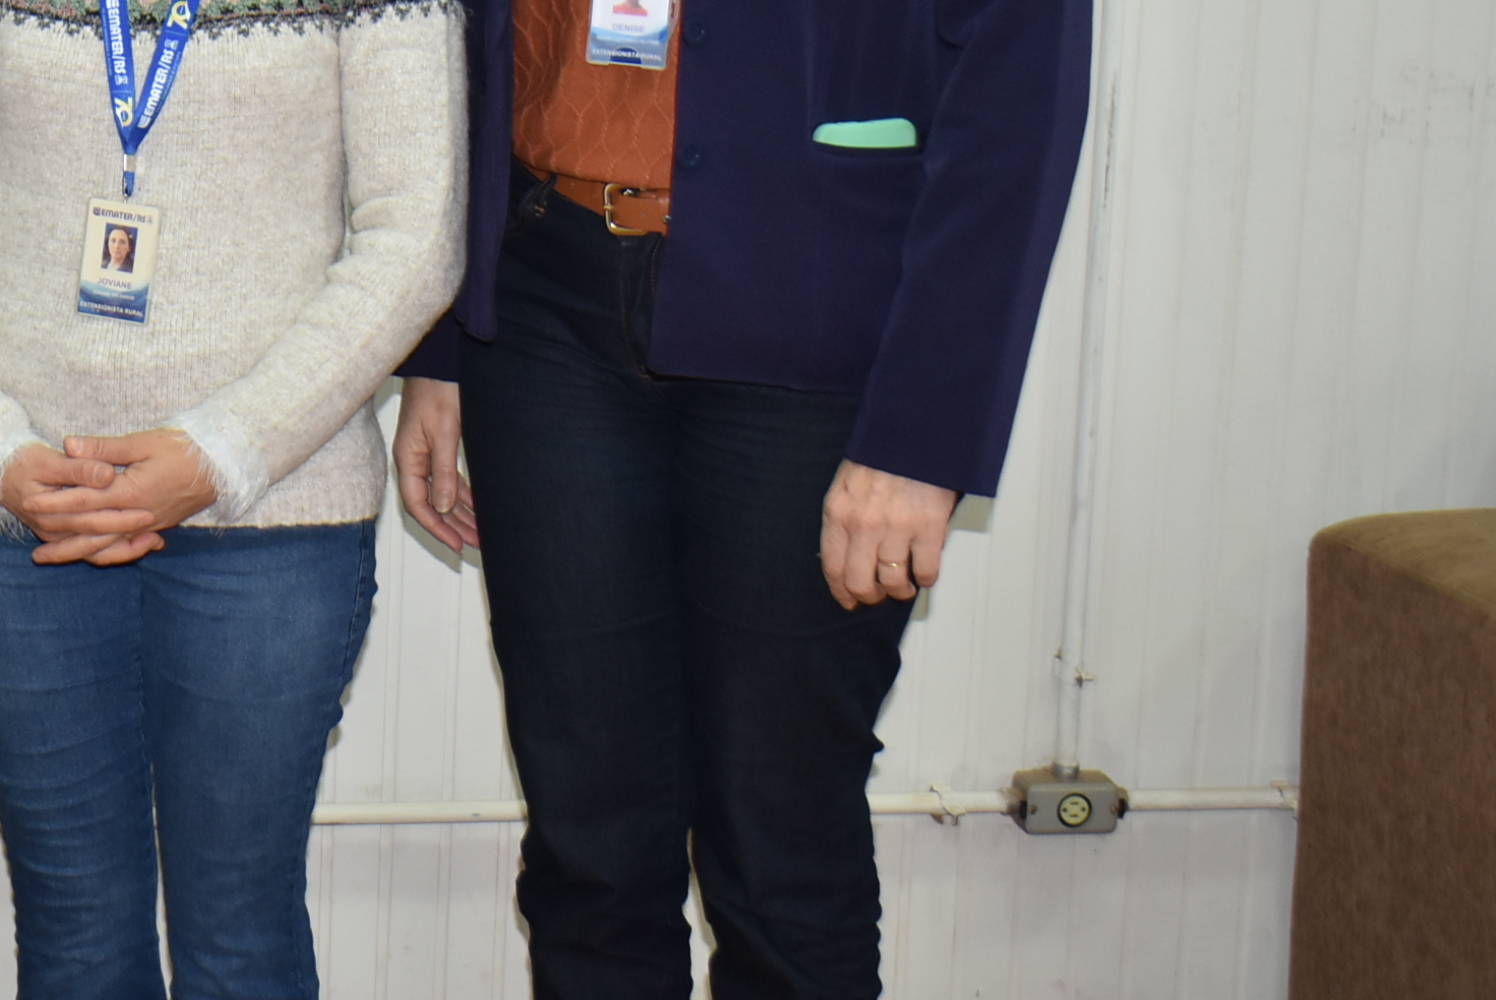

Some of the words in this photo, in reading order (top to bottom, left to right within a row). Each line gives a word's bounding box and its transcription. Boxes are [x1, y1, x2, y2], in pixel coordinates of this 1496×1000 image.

[612, 23, 645, 33] DENISE
[107, 7, 127, 75] EMATER/RS
[144, 47, 175, 118] EMATER/RS
[101, 208, 146, 223] EMATER/RS
[97, 277, 133, 289] JOVIANE
[80, 300, 124, 314] EXTENSIONISTA
[124, 308, 144, 317] RURAL
